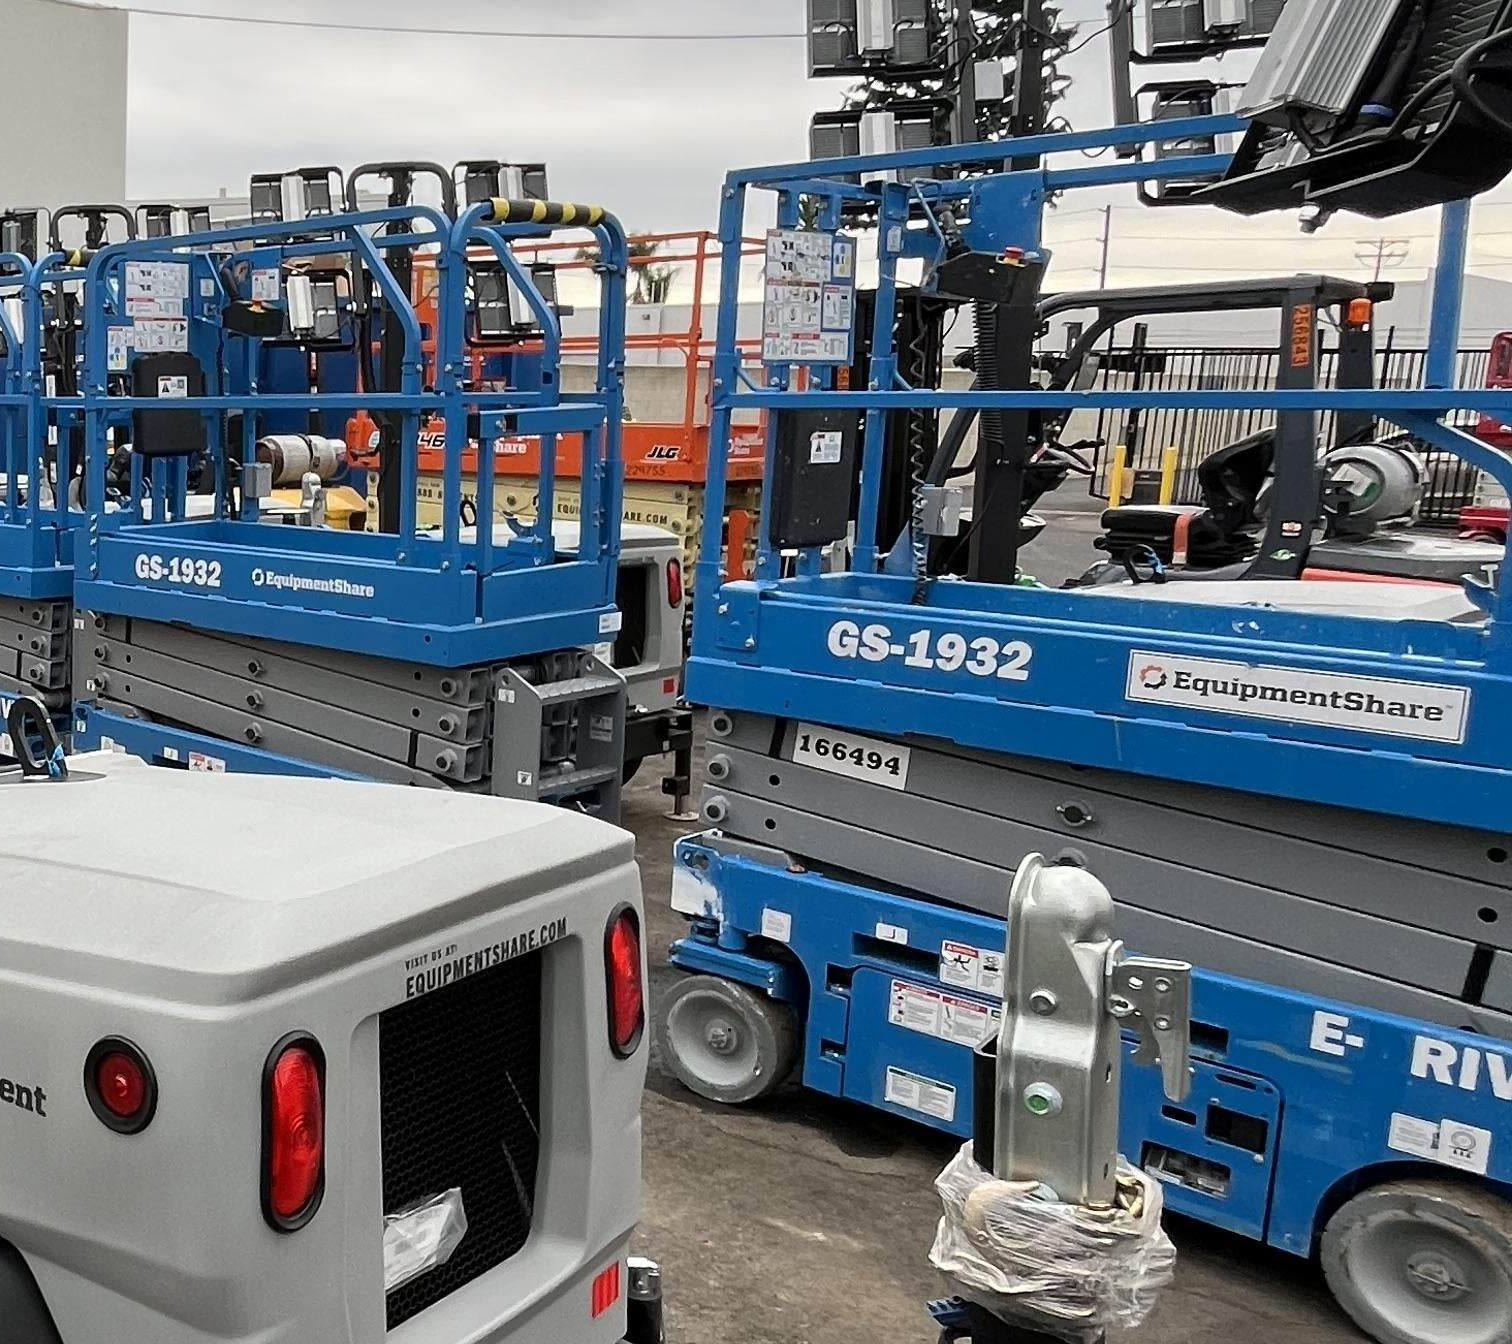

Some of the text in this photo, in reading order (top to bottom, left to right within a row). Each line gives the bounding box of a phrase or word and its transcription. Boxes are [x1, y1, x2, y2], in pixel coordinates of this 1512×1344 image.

[645, 444, 680, 461] JLG
[135, 554, 222, 588] GS-1932
[265, 570, 375, 598] EquipmentShare
[827, 619, 1034, 682] GS-1932
[1172, 669, 1445, 723] EquipmentShare
[799, 734, 900, 776] 166494
[405, 953, 428, 971] VISIT
[431, 950, 442, 961] US
[406, 917, 568, 998] EQUIPMENTSHARE.COM
[1310, 1010, 1364, 1056] E-
